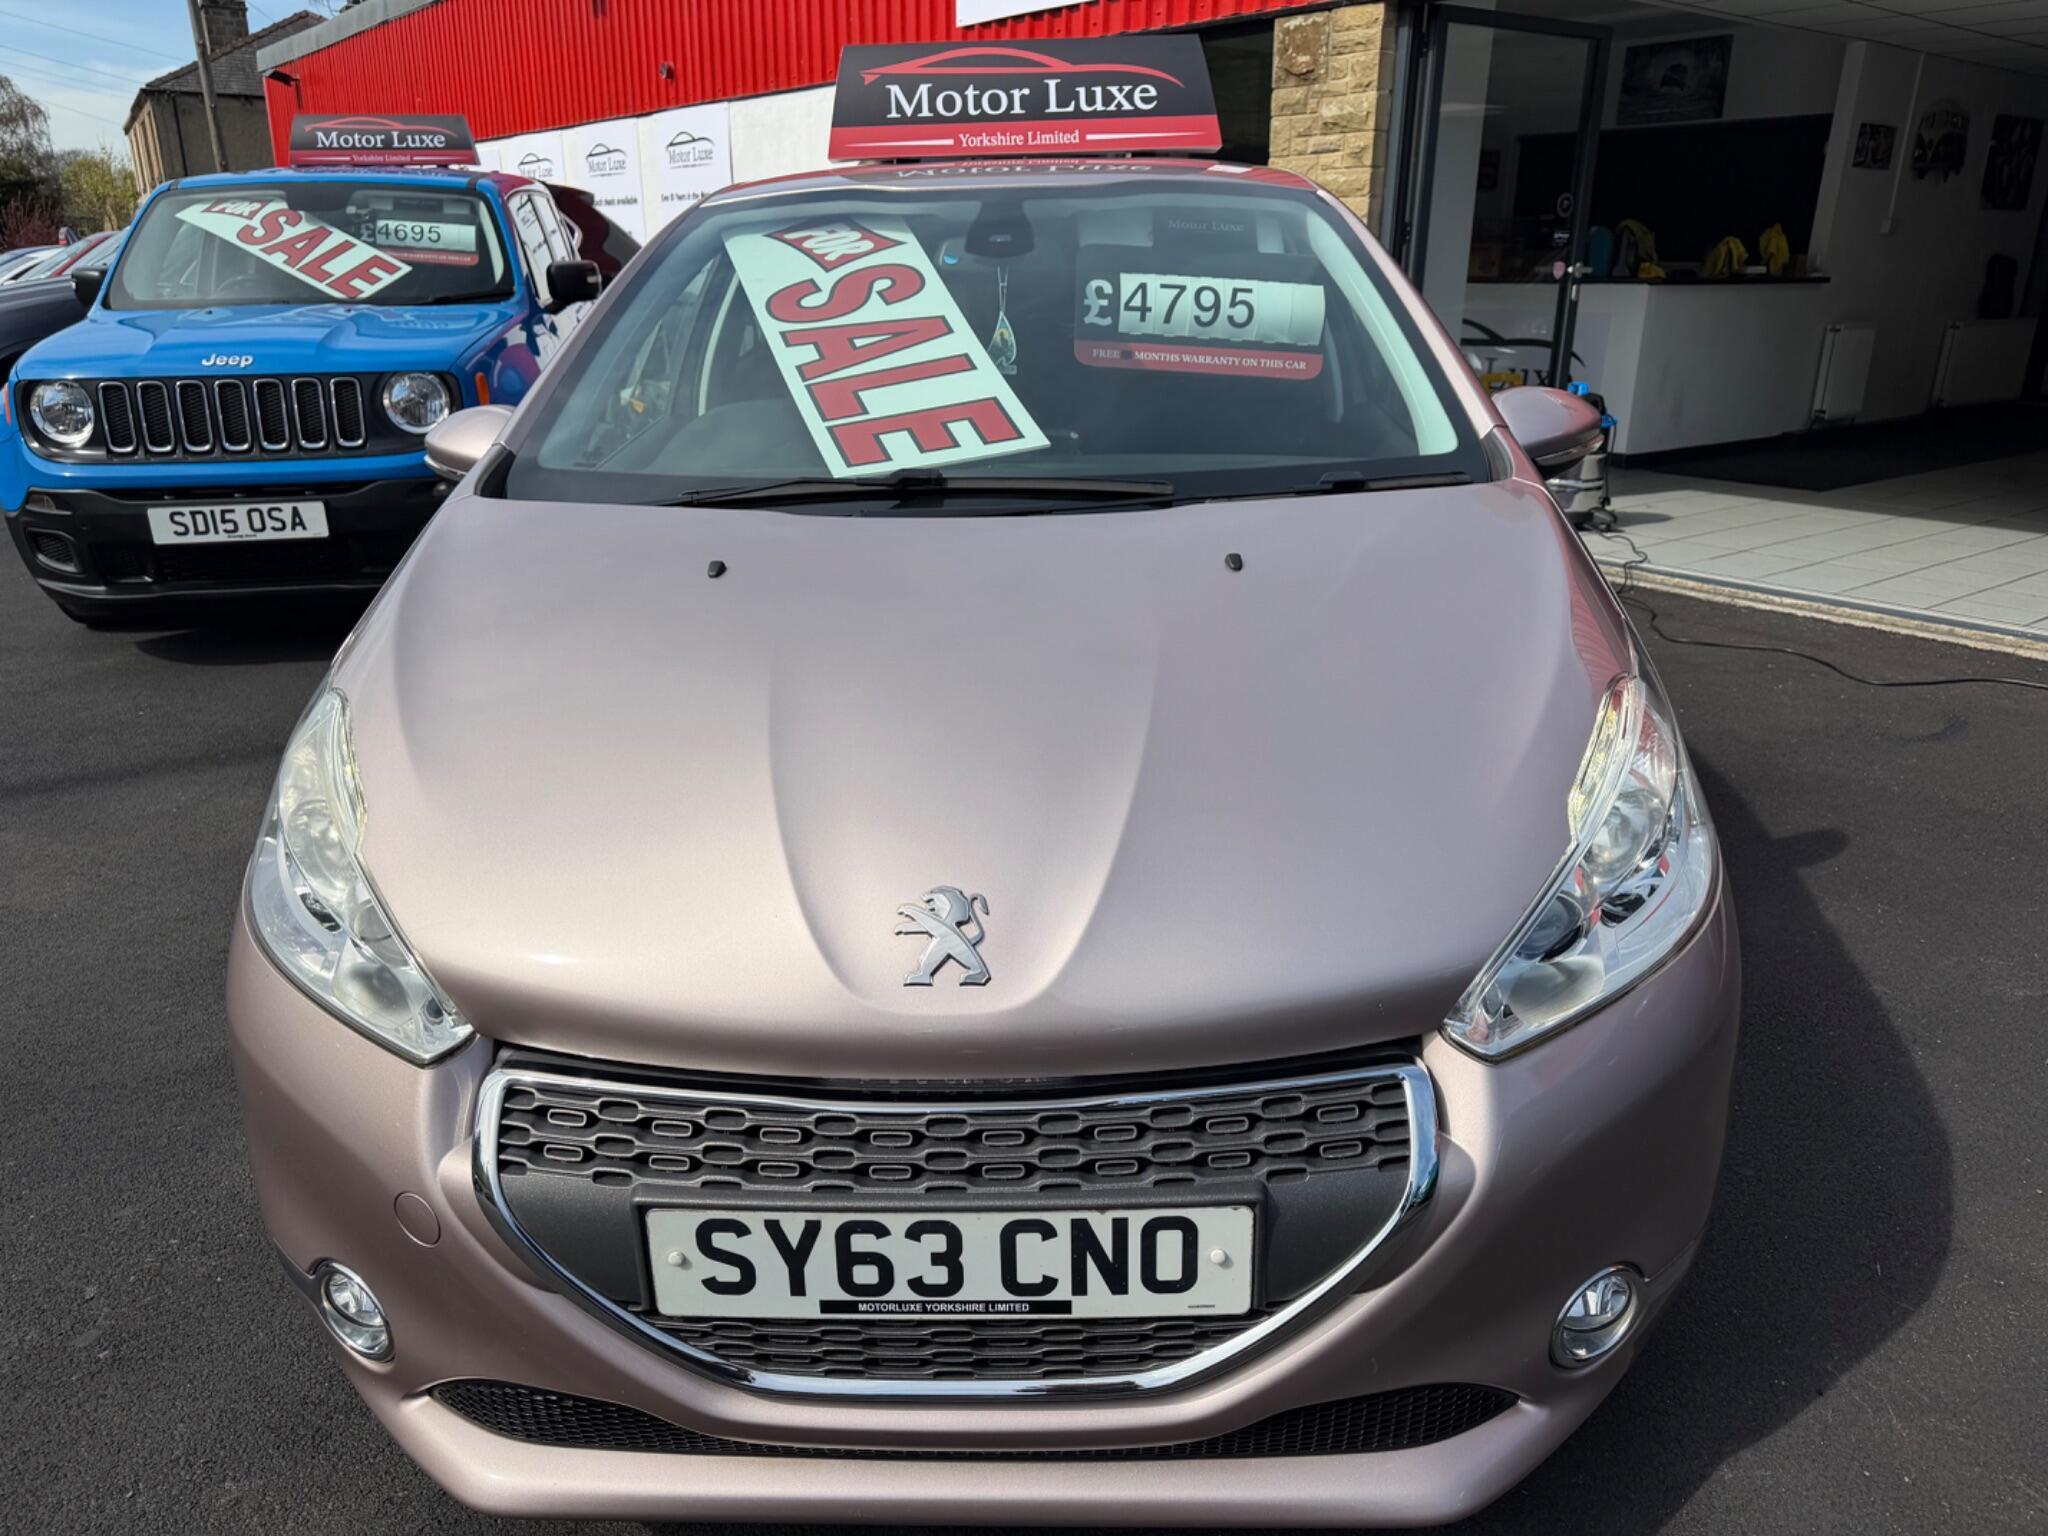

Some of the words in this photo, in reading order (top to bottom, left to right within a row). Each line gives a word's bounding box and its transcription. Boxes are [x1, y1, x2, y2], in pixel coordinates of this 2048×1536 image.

[885, 81, 1030, 118] Motor
[1043, 78, 1158, 113] Luxe
[315, 131, 385, 149] Motor
[392, 130, 446, 148] Luxe
[959, 131, 1024, 148] Yorkshire
[1027, 129, 1080, 146] Limited
[210, 199, 262, 218] FOR
[236, 208, 402, 298] SALE
[783, 227, 875, 262] FOR
[201, 353, 254, 368] Jeep
[765, 263, 1025, 468] SALE
[1092, 348, 1120, 359] FREE
[1134, 351, 1180, 363] MONTHS
[1180, 353, 1242, 366] WARRANTY
[1241, 357, 1259, 368] ON
[1260, 358, 1284, 369] THIS
[1284, 360, 1307, 370] CAR
[169, 509, 239, 536] SD15
[246, 506, 308, 533] OSA
[695, 1216, 965, 1298] SY63
[999, 1215, 1199, 1297] CNO
[858, 1302, 922, 1313] MOTORLUXE
[924, 1302, 986, 1313] YORKSHIRE
[988, 1302, 1030, 1312] LIMITED
